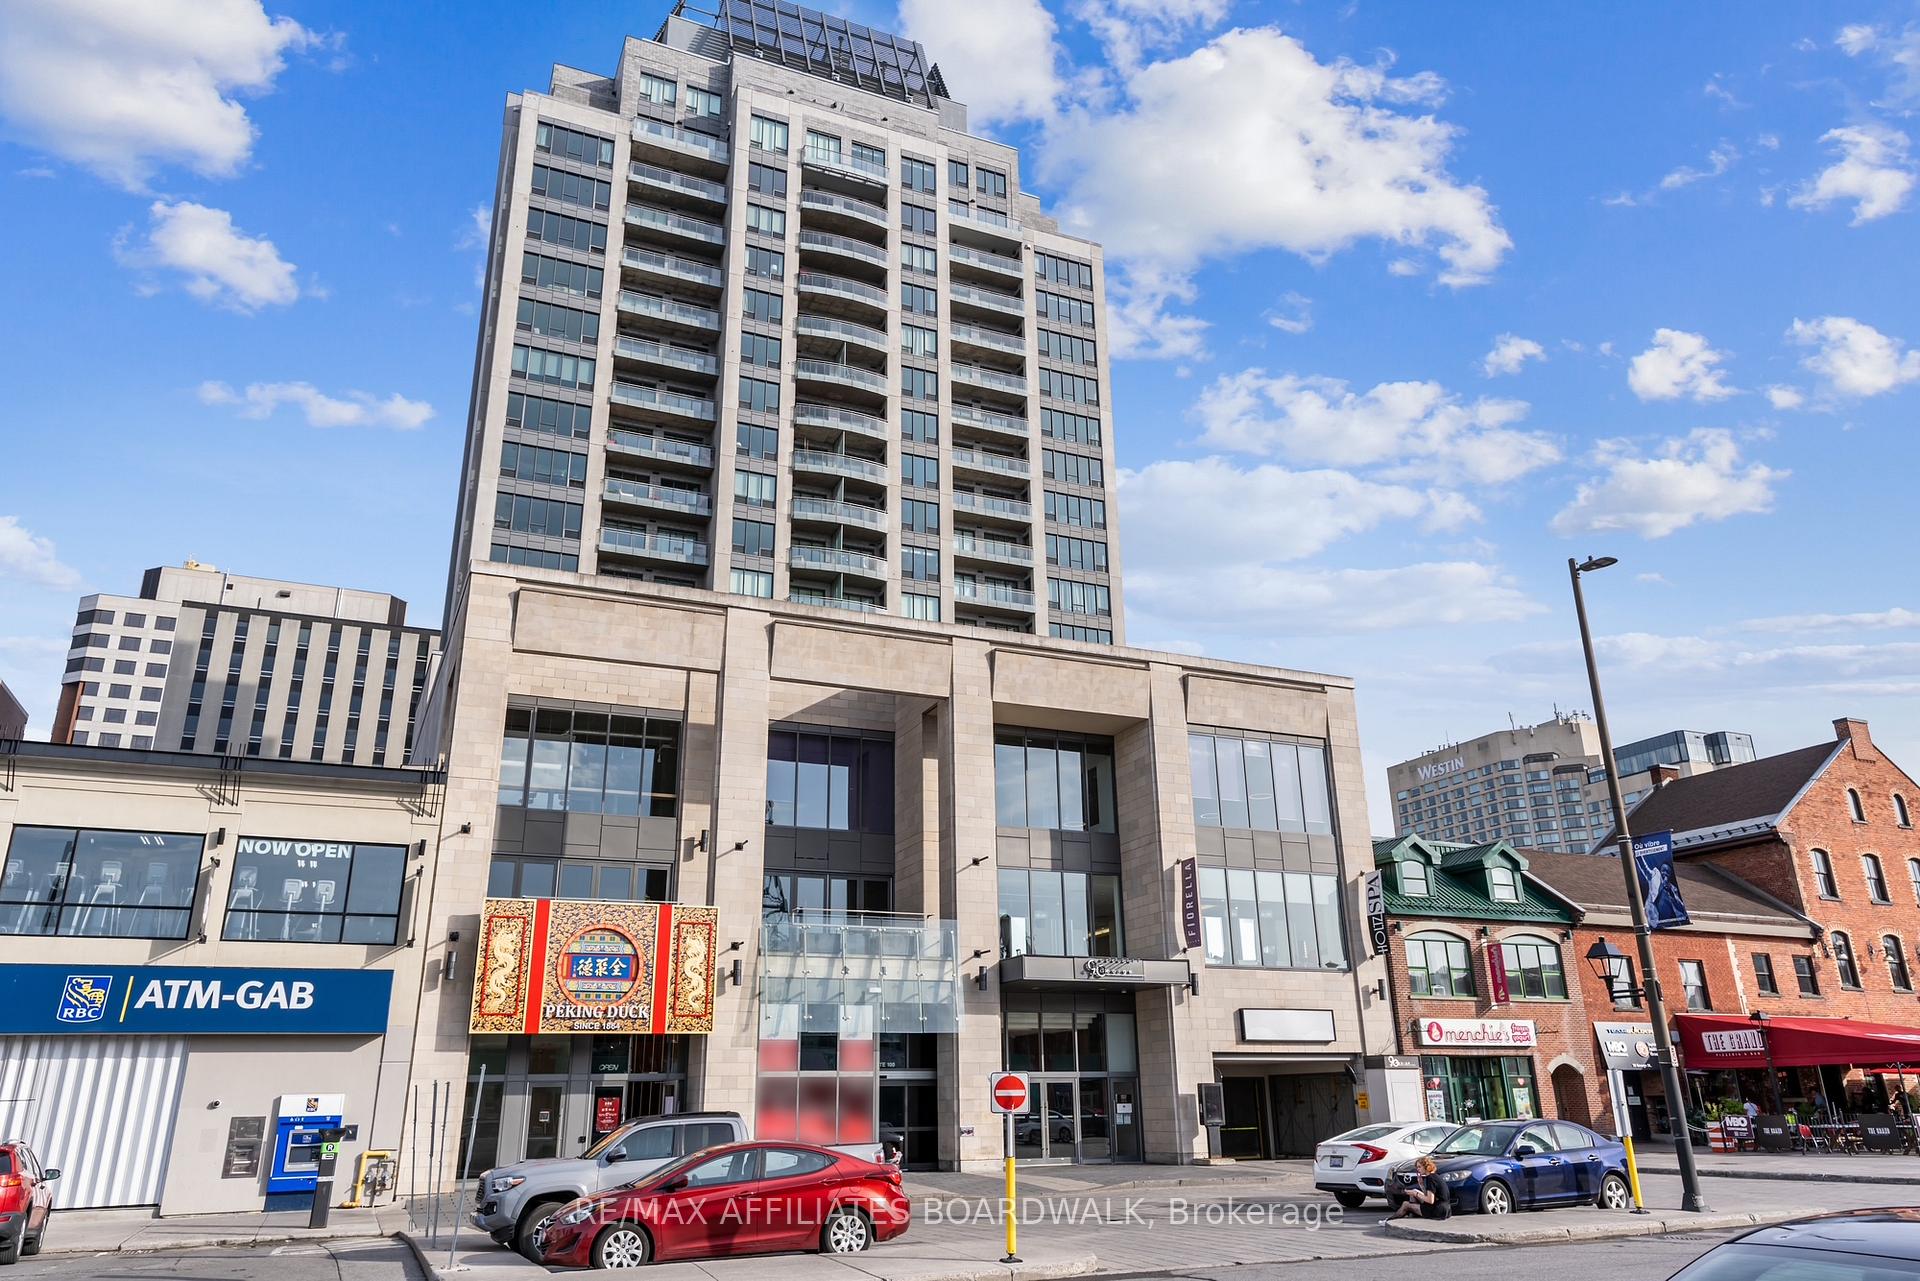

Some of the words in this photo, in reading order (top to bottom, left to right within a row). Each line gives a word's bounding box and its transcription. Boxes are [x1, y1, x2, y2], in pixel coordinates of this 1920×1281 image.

[1417, 757, 1465, 781] WESTIN
[238, 839, 292, 856] NOW
[294, 842, 353, 859] OPEN
[1184, 862, 1196, 937] FIORELLA
[1367, 875, 1382, 913] SPA
[133, 979, 315, 1010] ATM-GAB
[62, 1007, 100, 1019] RBC
[545, 1004, 604, 1019] PEKING
[607, 1004, 650, 1019] DUCK
[574, 1022, 600, 1030] SINCE
[1445, 1024, 1510, 1043] menchie's
[1704, 1033, 1726, 1051] THE
[1725, 1116, 1748, 1127] MBO
